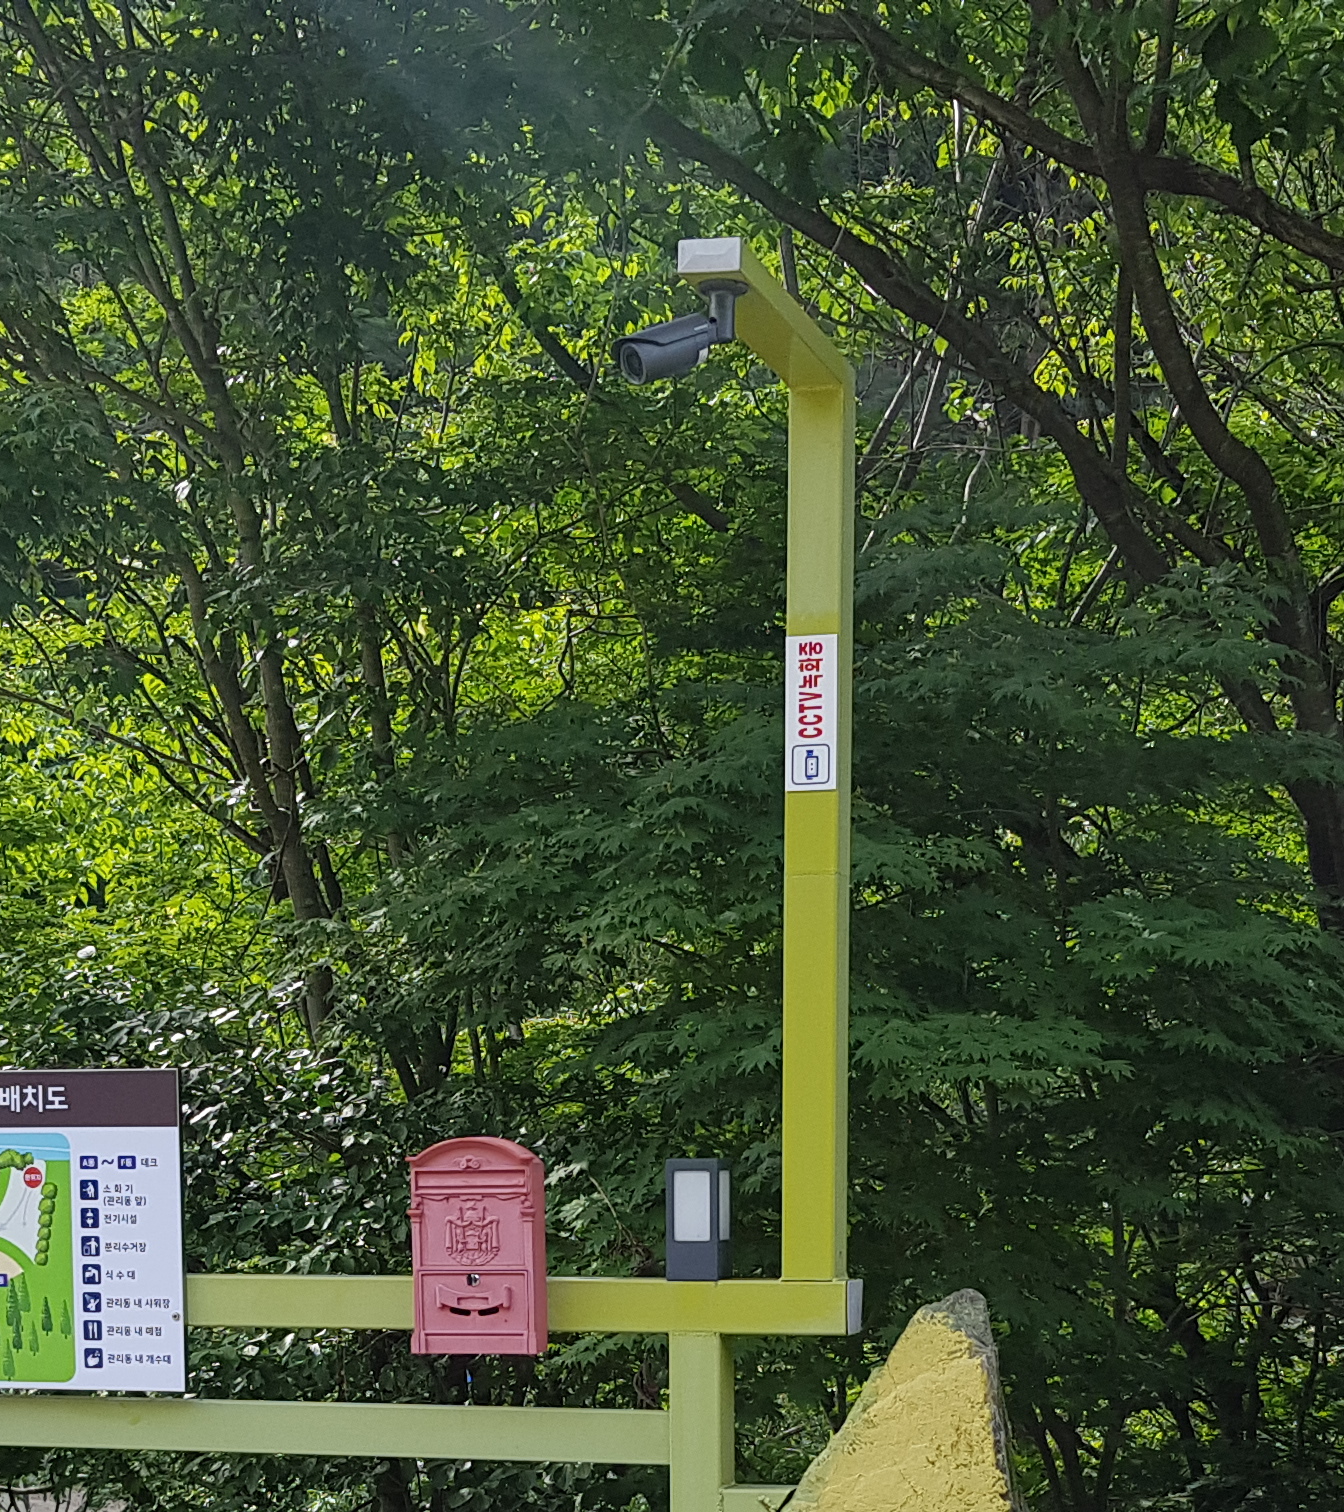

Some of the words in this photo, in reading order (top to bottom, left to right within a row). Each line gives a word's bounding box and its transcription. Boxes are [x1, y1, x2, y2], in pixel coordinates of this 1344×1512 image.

[798, 641, 824, 739] CCTV녹화중
[0, 1084, 69, 1114] 배치도
[140, 1157, 158, 1168] 데크
[103, 1213, 138, 1225] 전기시설
[104, 1241, 147, 1253] 분리수거장
[106, 1297, 131, 1309] 관리동
[133, 1297, 143, 1309] 내
[145, 1297, 171, 1309] 샤워장
[106, 1325, 131, 1337] 관리동
[134, 1325, 143, 1337] 내
[107, 1353, 132, 1365] 관리동
[134, 1353, 143, 1365] 내
[145, 1353, 172, 1365] 개수대
